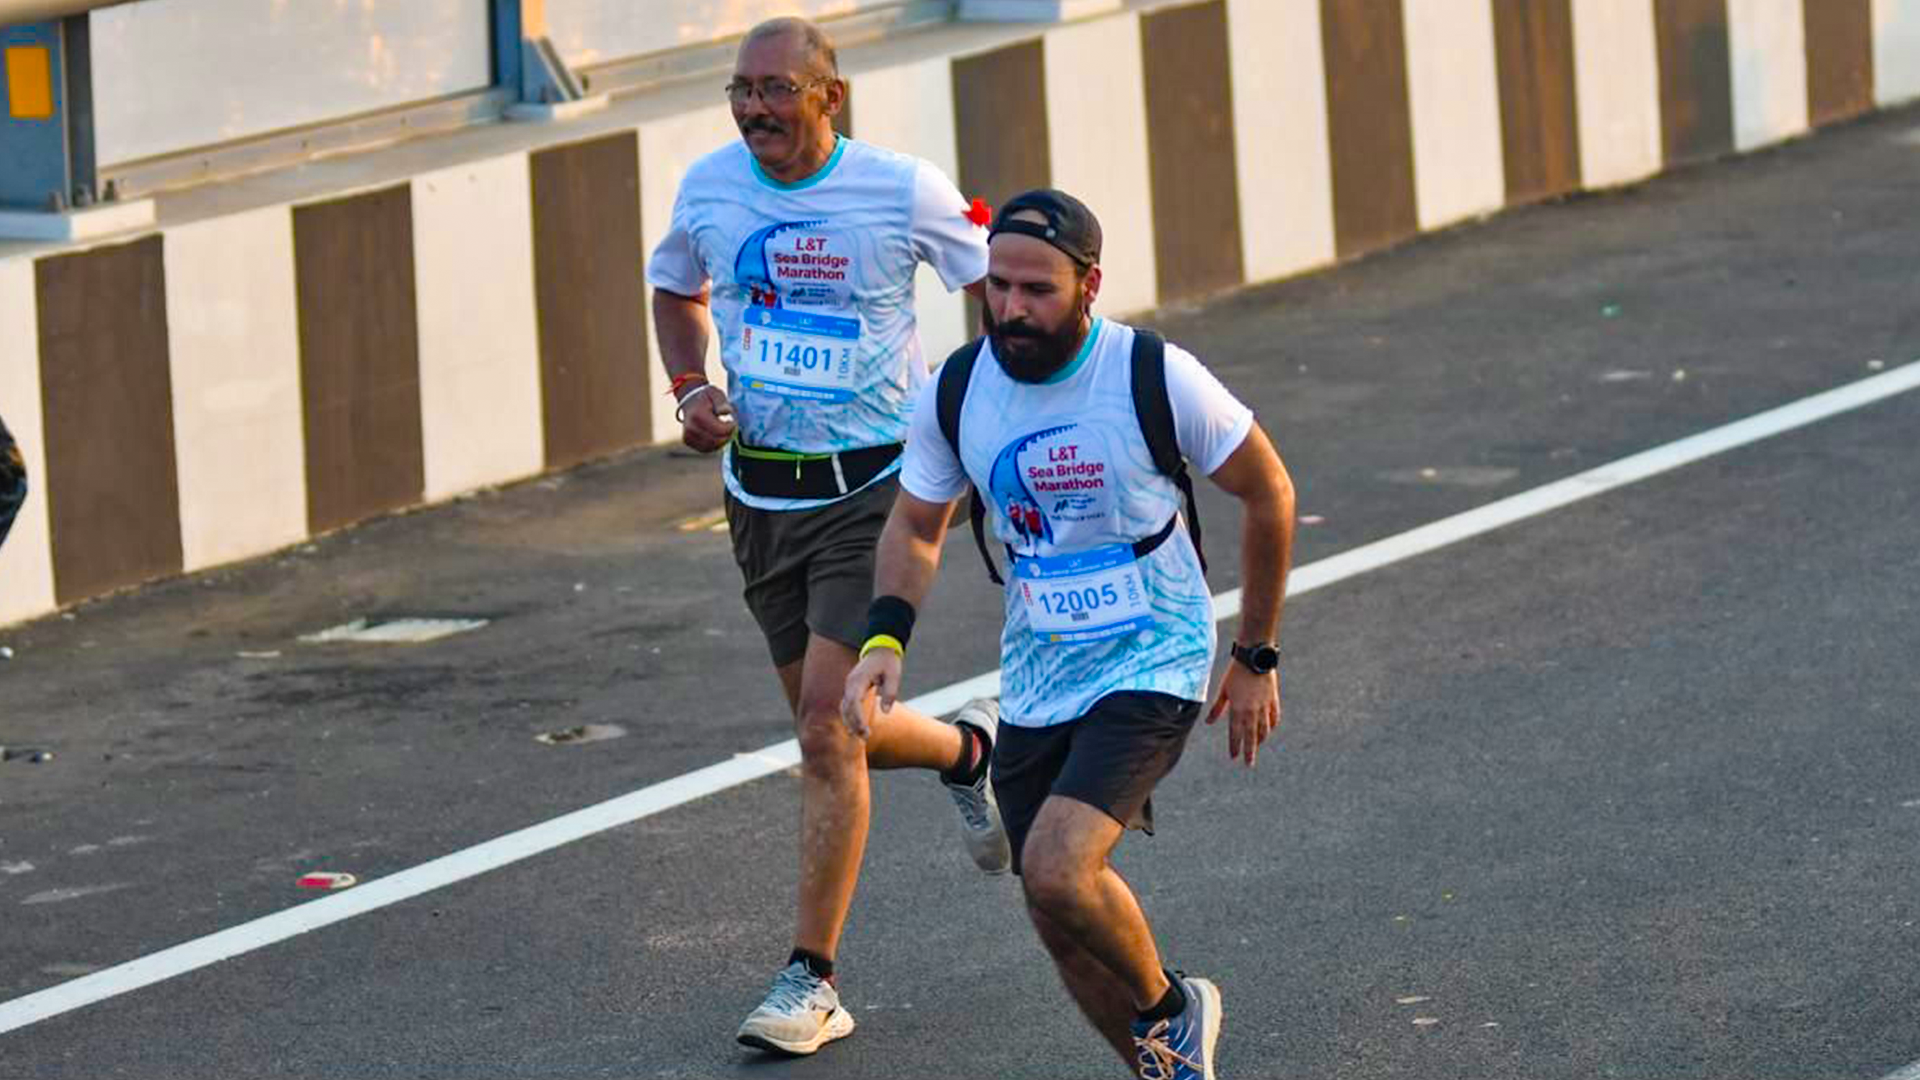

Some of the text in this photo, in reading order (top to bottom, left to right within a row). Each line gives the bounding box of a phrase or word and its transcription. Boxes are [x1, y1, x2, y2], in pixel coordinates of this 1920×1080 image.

[795, 236, 827, 252] L&T
[774, 253, 850, 269] Sea Bridge
[777, 266, 845, 280] Marathon
[760, 340, 831, 371] 11401
[837, 347, 852, 379] 10KM
[1048, 445, 1078, 462] L&T
[1028, 461, 1104, 479] Sea Bridge
[1034, 477, 1104, 493] Marathon
[1039, 582, 1118, 614] 12005
